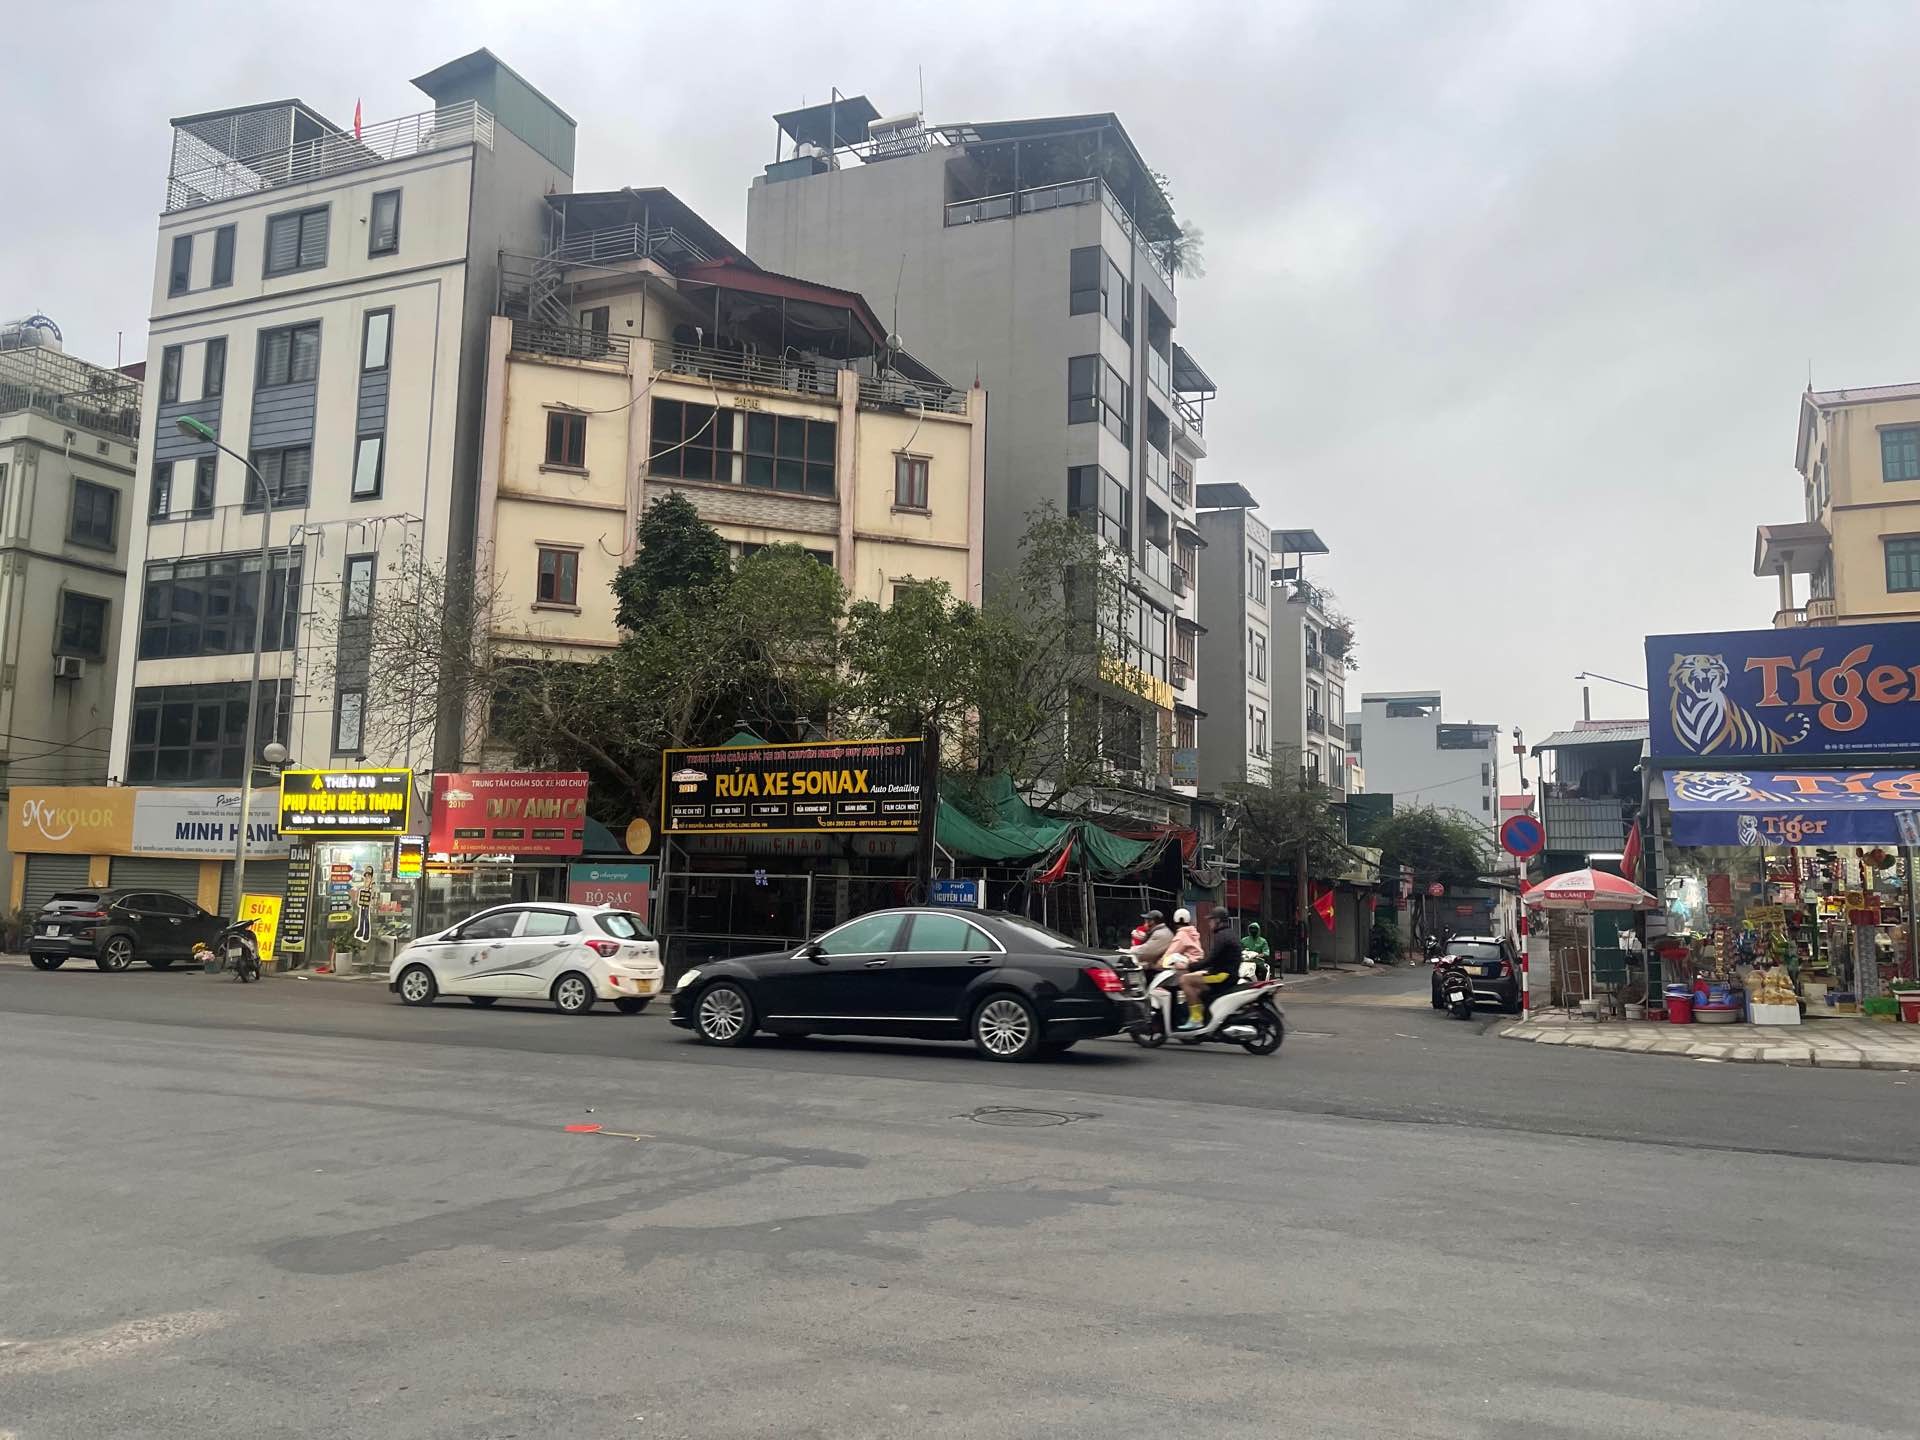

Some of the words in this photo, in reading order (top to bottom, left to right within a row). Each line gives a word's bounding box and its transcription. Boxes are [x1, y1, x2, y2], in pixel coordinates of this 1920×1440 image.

[325, 774, 357, 789] THIÊN
[358, 775, 376, 788] AN
[472, 779, 494, 787] TRUNG
[495, 778, 509, 787] TÂM
[545, 779, 555, 787] XE
[715, 767, 759, 797] RỬA
[763, 771, 789, 796] XE
[792, 769, 869, 795] SONAX
[870, 784, 887, 794] Auto
[888, 783, 920, 794] Detailing
[283, 793, 307, 814] PHỤ
[308, 791, 336, 814] KIỆN
[338, 791, 366, 814] ĐIỆN
[369, 793, 403, 814] THOẠI
[486, 798, 522, 819] DUY
[175, 822, 223, 841] MINH
[230, 823, 283, 847] HẠNH
[1762, 814, 1828, 843] Tiger
[290, 846, 310, 860] DÁN
[585, 888, 604, 906] BỘ
[606, 891, 632, 906] SẠC
[934, 890, 958, 902] NGUYỄN
[959, 893, 974, 903] LAM
[250, 919, 272, 936] IỆN
